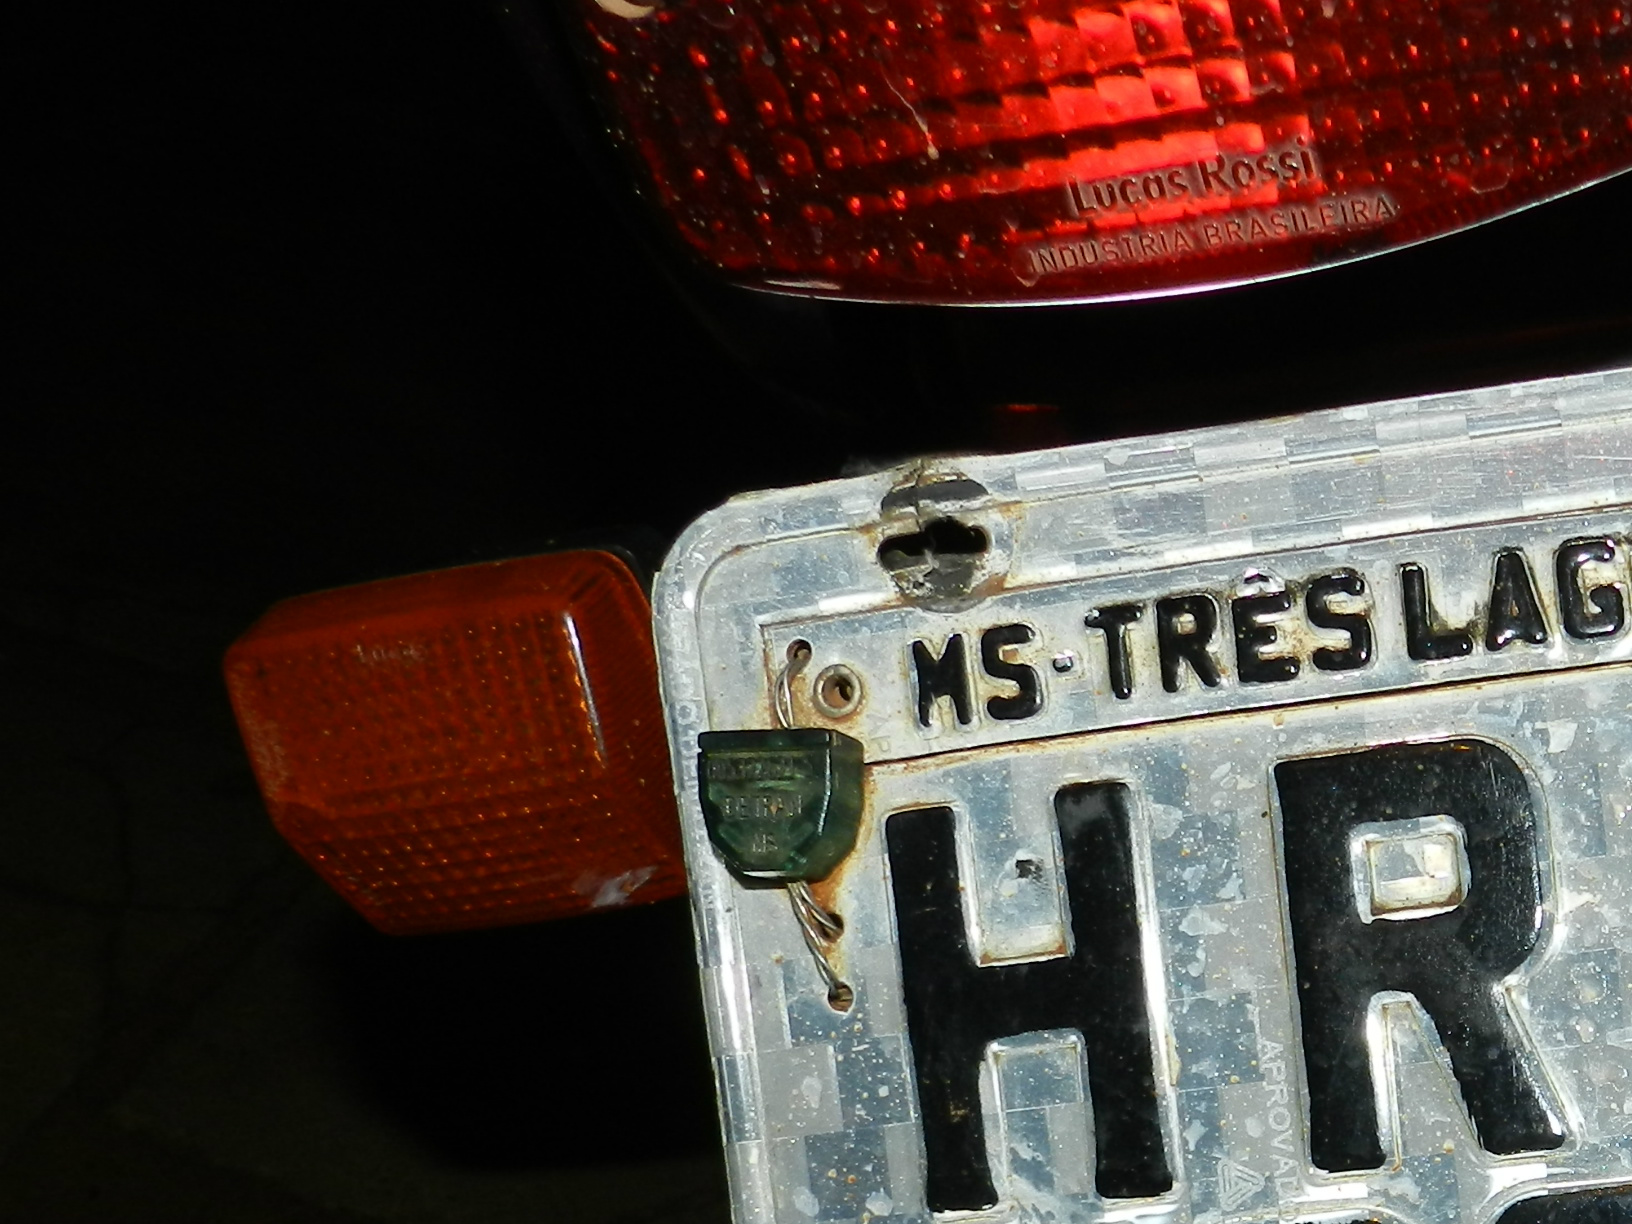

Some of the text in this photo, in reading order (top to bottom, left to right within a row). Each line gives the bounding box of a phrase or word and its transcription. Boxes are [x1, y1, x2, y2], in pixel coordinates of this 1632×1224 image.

[1066, 136, 1318, 215] Lucas Rossi
[1028, 194, 1396, 274] INDUSTRIA BRASILEIRA
